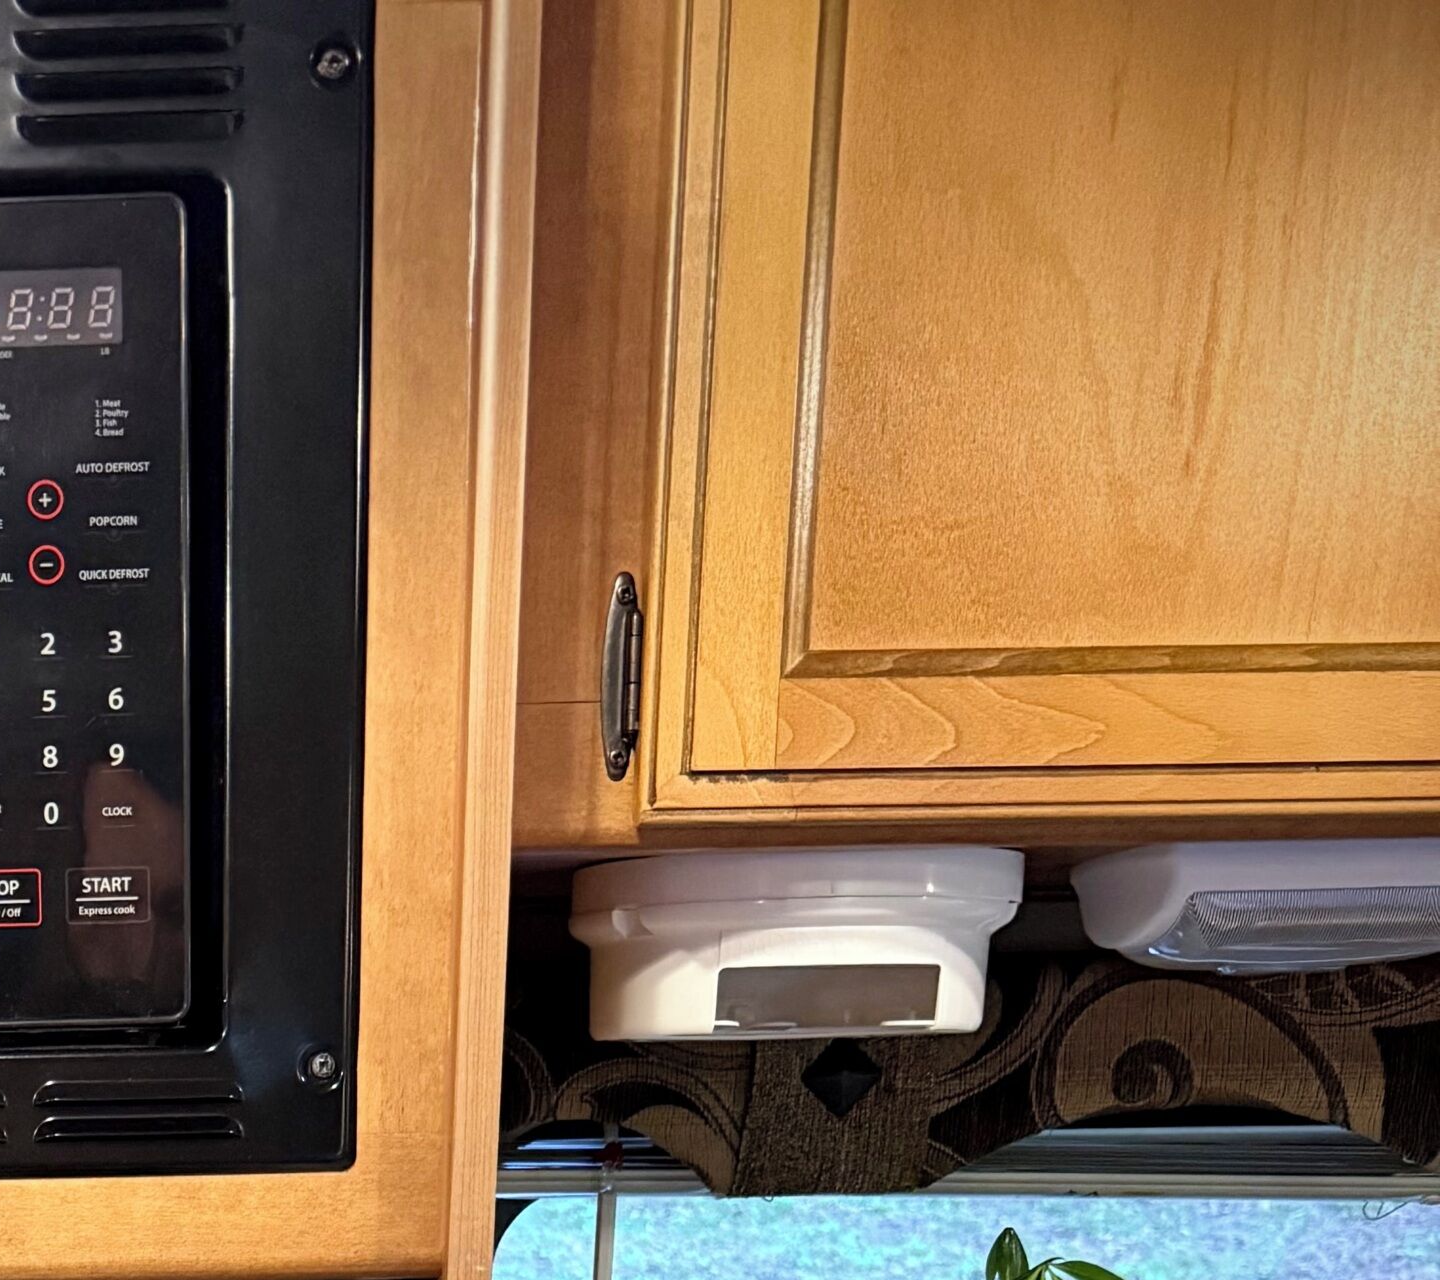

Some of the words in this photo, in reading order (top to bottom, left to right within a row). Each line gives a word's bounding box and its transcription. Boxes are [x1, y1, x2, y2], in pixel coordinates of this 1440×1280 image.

[103, 409, 129, 418] Poultry
[76, 462, 103, 474] AUTO
[104, 461, 150, 473] DEFROST
[89, 516, 138, 527] POPCORN
[79, 569, 109, 580] QUICK
[110, 568, 150, 579] DEFROST
[40, 632, 56, 655] 2
[108, 630, 123, 653] 3
[42, 690, 57, 712] 5
[108, 688, 124, 710] 6
[43, 746, 58, 768] 8
[109, 744, 124, 766] 9
[44, 803, 59, 825] 0
[102, 806, 132, 817] CLOCK
[82, 876, 132, 893] START
[7, 907, 22, 918] Off
[78, 906, 112, 917] Express
[113, 904, 136, 915] cook
